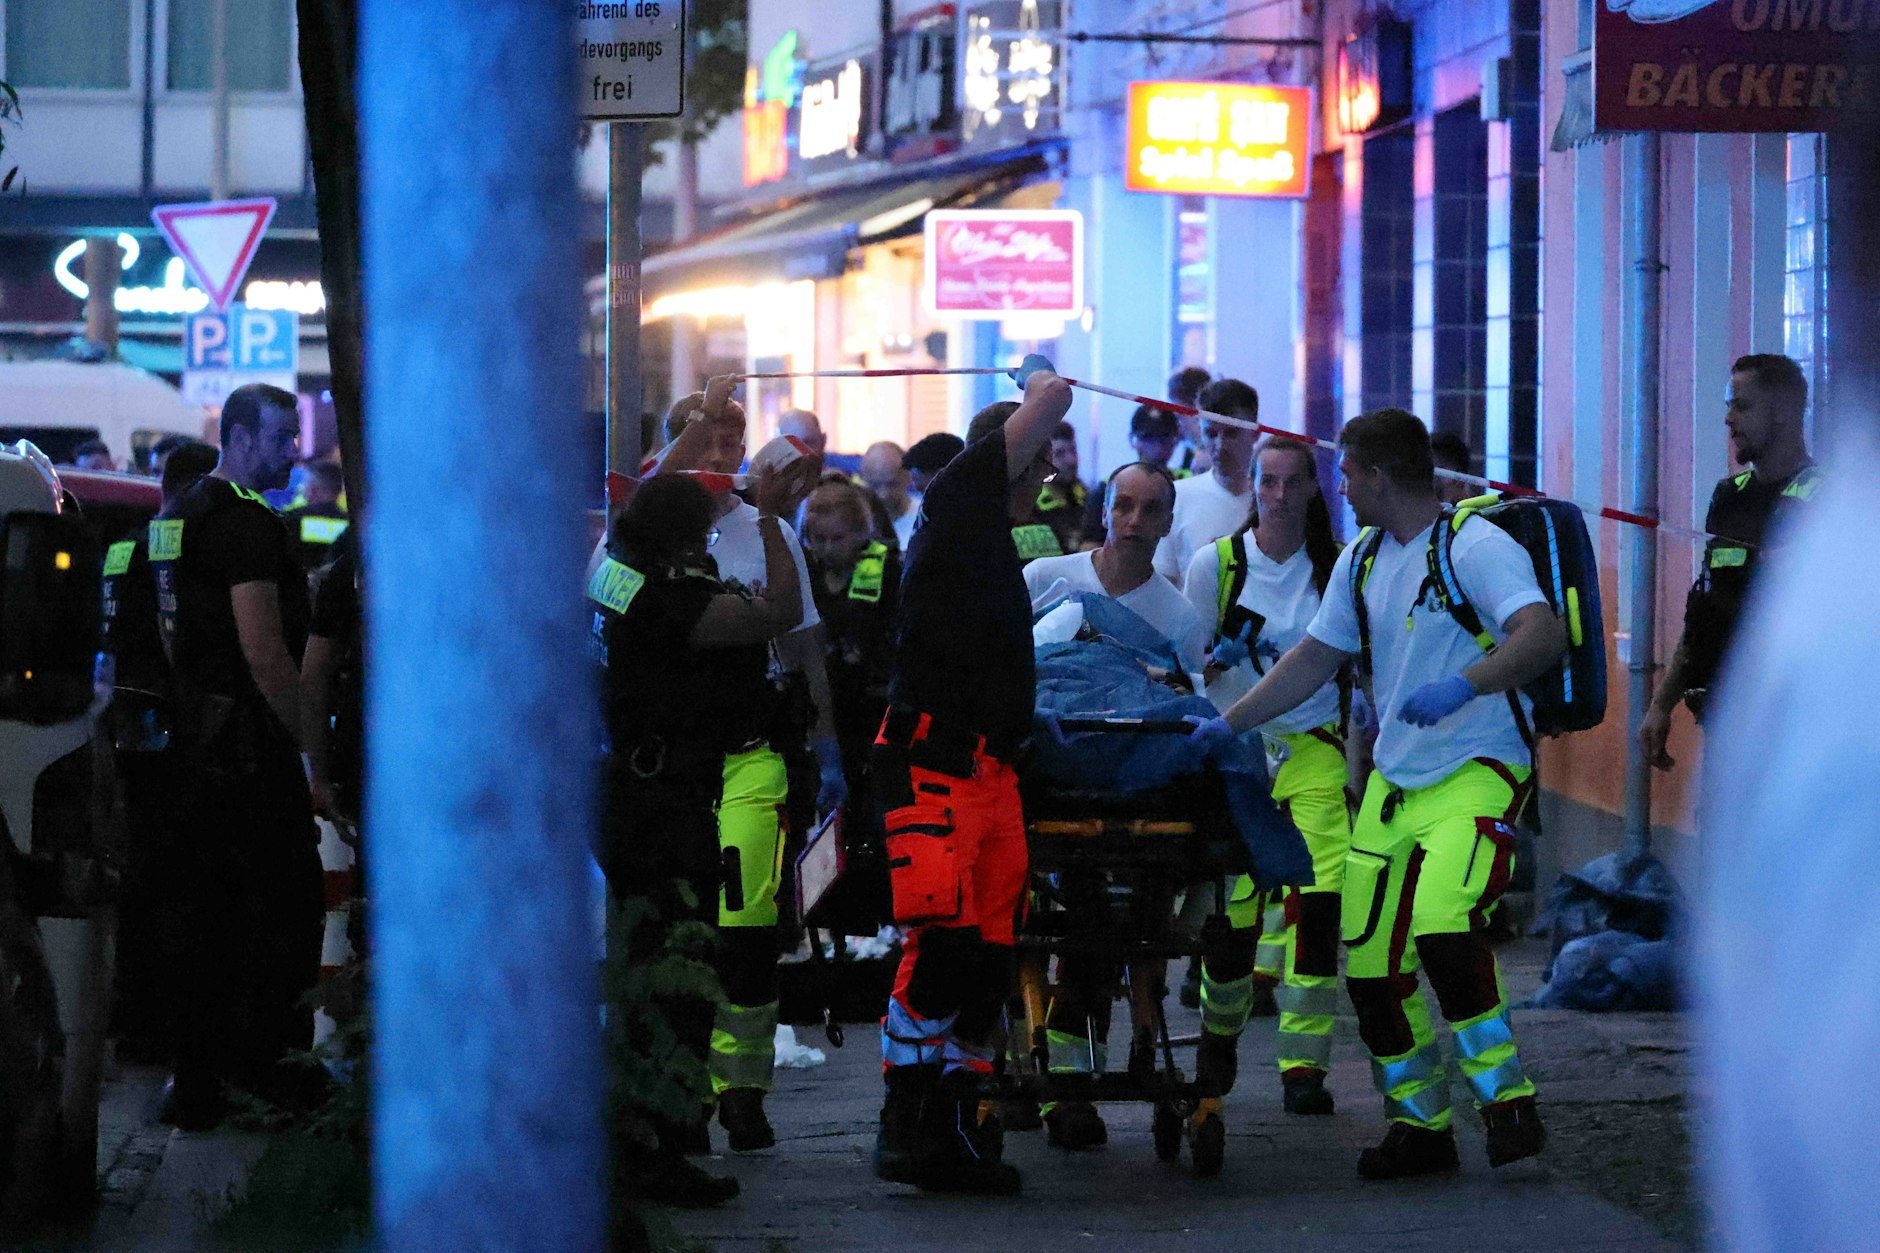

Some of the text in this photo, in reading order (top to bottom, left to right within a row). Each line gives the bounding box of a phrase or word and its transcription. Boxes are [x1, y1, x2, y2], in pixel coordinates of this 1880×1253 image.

[635, 0, 661, 18] des
[593, 74, 632, 101] frei
[192, 317, 227, 365] P
[241, 315, 278, 365] P
